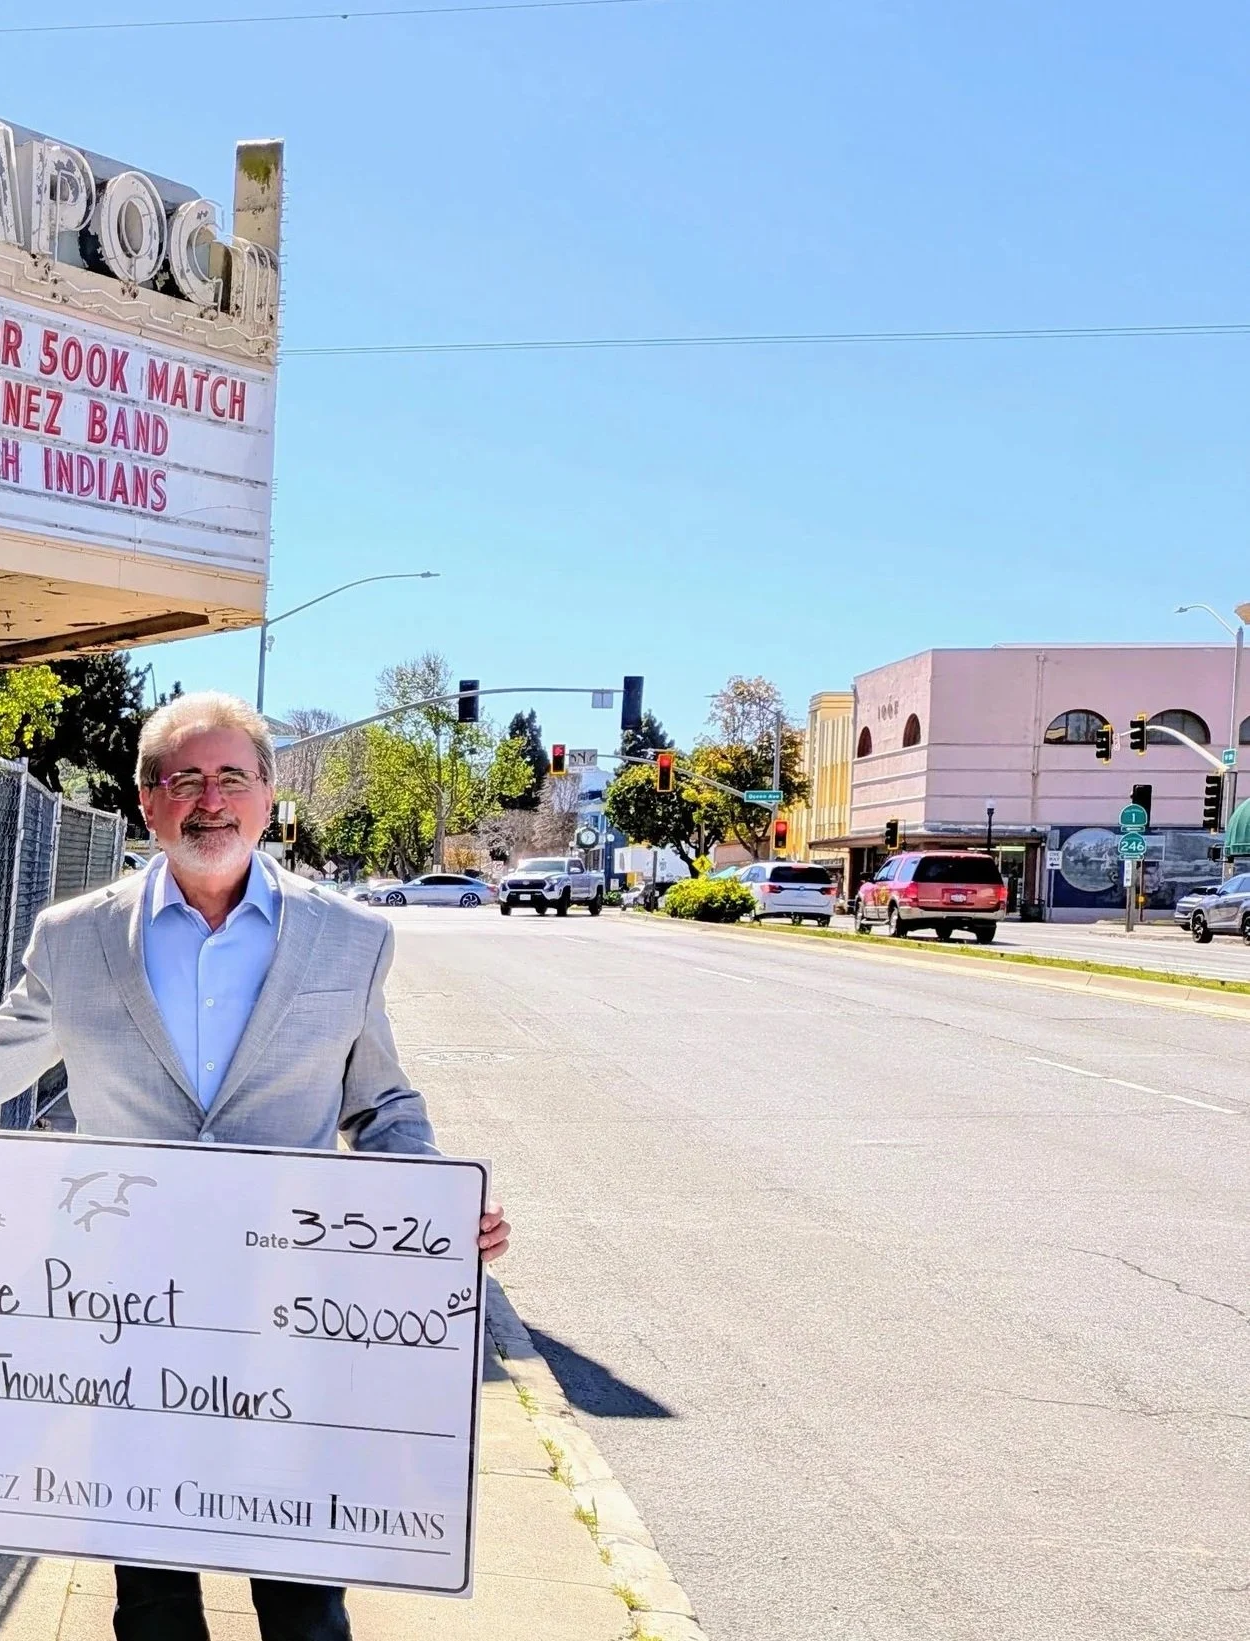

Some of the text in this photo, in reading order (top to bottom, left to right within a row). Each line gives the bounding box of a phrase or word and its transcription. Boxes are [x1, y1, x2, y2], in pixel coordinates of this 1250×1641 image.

[39, 330, 130, 394] 500K
[148, 358, 246, 421] MATCH
[88, 400, 168, 456] BAND
[43, 447, 167, 512] INDIANS
[1131, 812, 1136, 823] 1
[1120, 841, 1145, 852] 246
[246, 1231, 289, 1249] Date
[292, 1209, 451, 1255] 3-5-26
[45, 1258, 185, 1344] Project
[161, 1367, 292, 1419] Dollars
[34, 1466, 113, 1508] BAND
[126, 1485, 161, 1512] OF
[175, 1480, 312, 1528] CHUMASH
[328, 1493, 445, 1540] INDIANS
